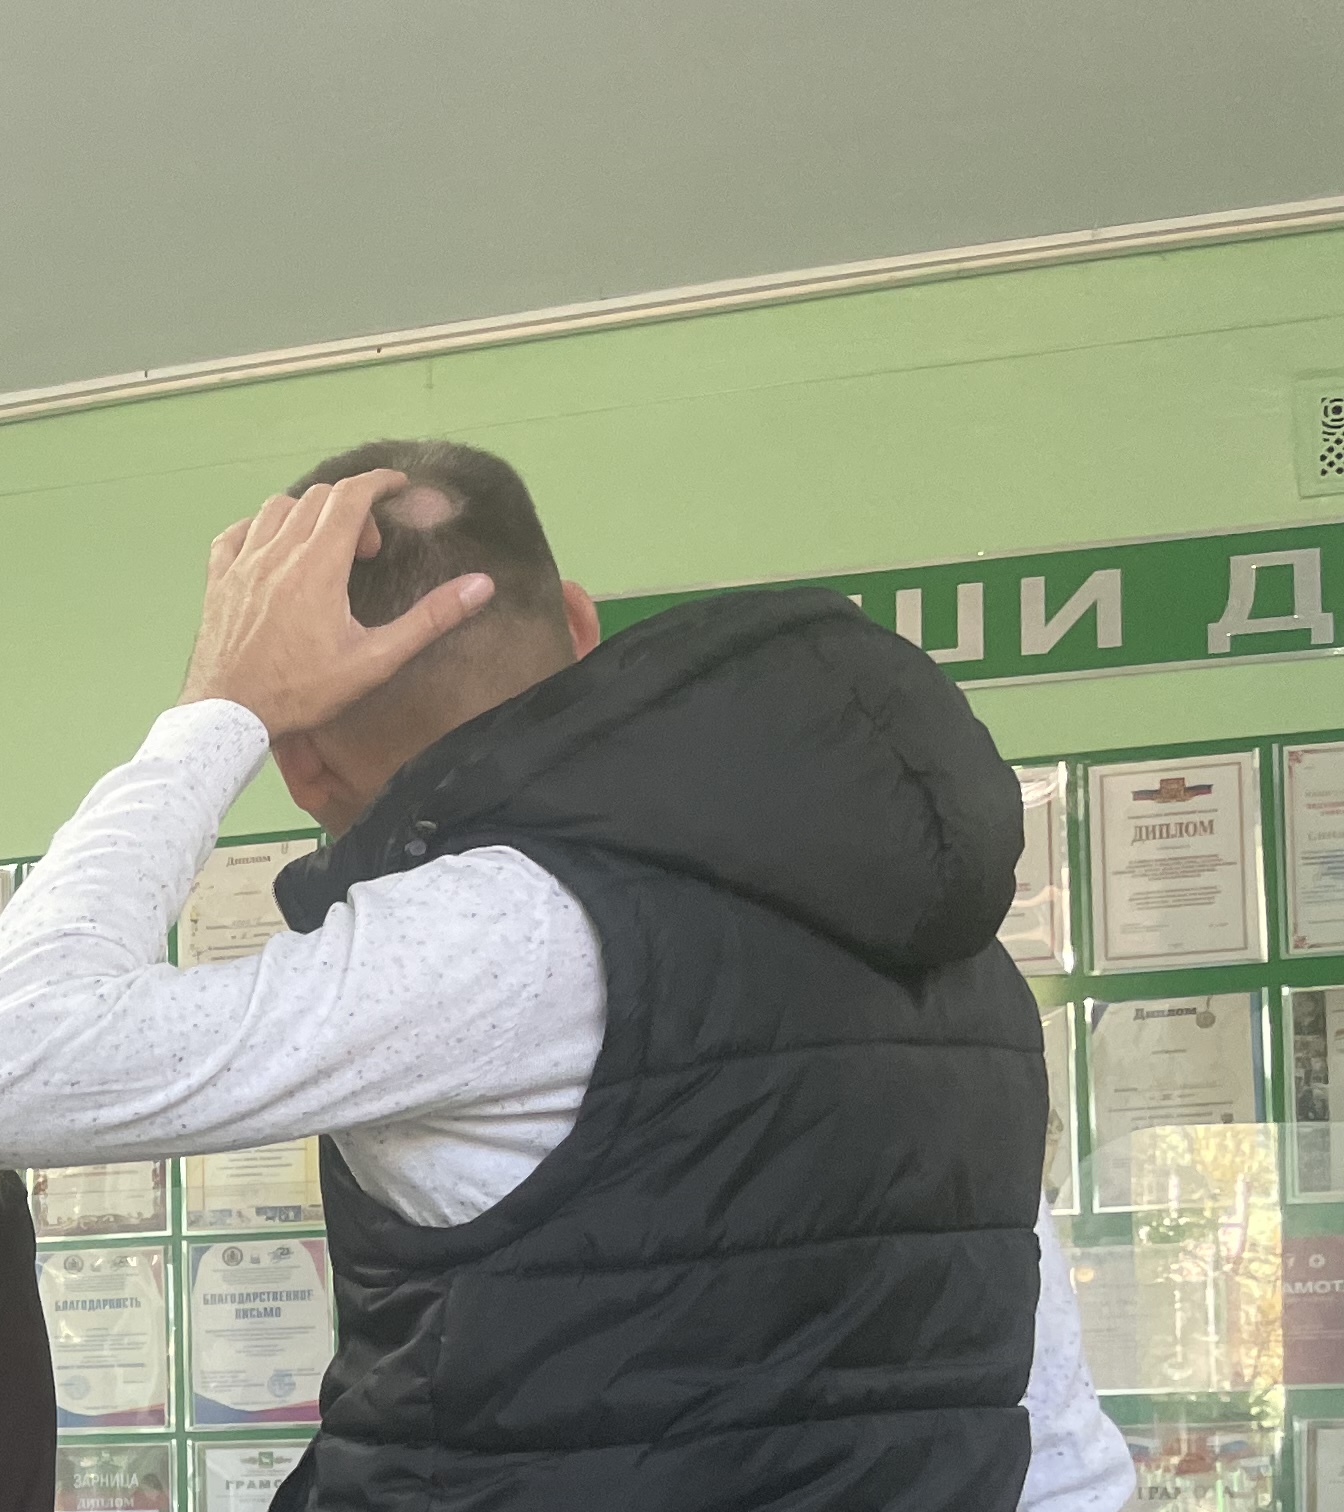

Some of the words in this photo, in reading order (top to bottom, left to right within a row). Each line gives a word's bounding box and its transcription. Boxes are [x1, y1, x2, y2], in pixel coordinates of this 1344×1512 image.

[1207, 547, 1334, 654] Д
[1130, 820, 1215, 846] ДИПЛОМ
[55, 1297, 142, 1312] БЛАГОДАРНОСТЬ
[202, 1289, 314, 1305] БЛАГОДАРСТВЕННОЕ
[235, 1307, 282, 1320] ПИСЬМО
[73, 1473, 139, 1488] ЗАРНИЦА
